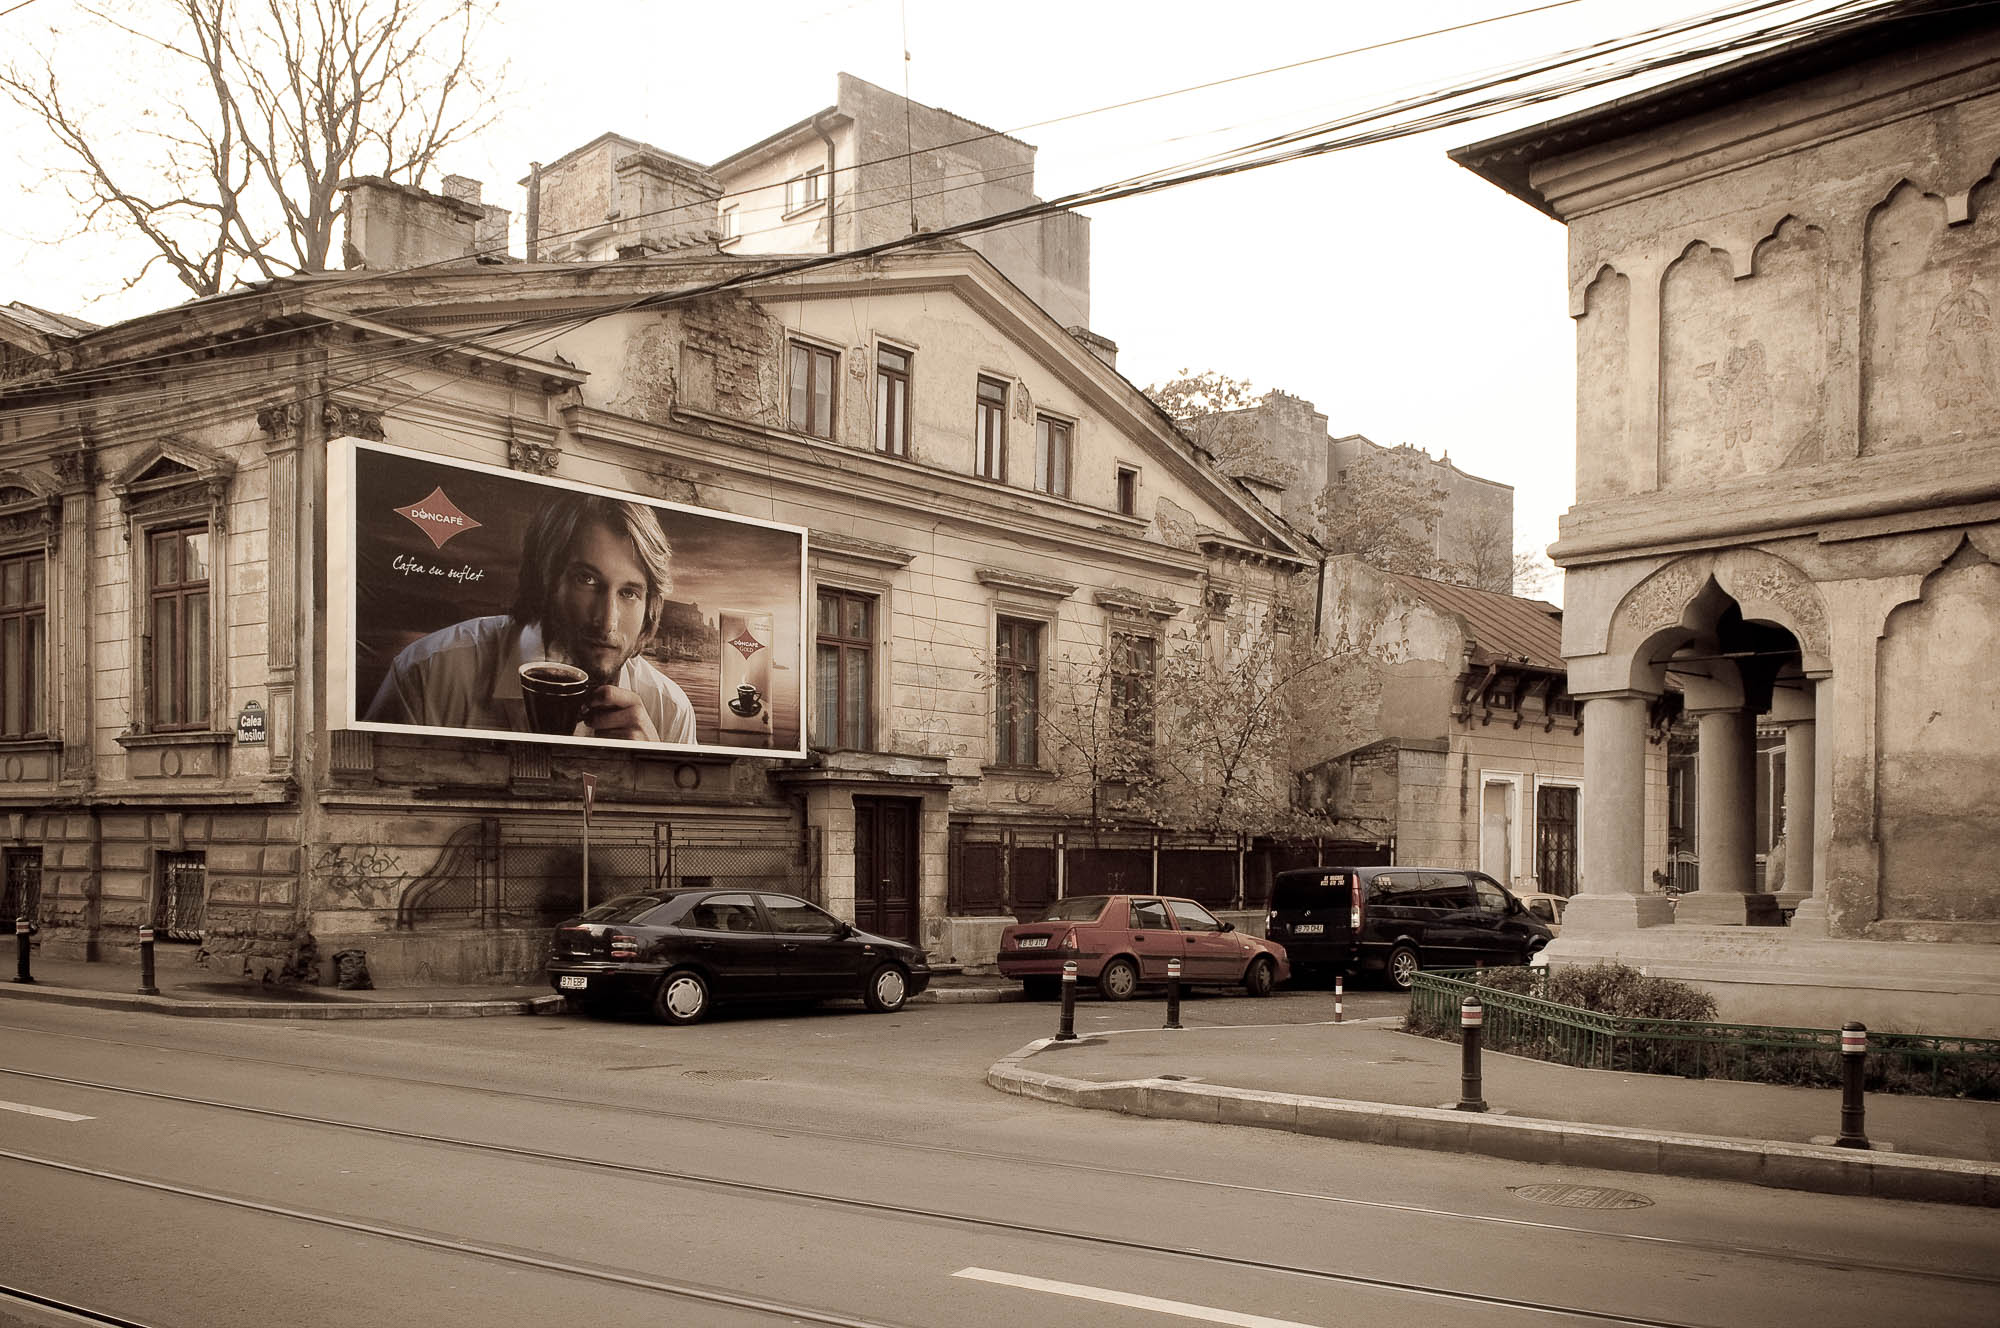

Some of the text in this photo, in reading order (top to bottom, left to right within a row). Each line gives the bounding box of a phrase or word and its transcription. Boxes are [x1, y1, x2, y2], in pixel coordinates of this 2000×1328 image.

[411, 508, 464, 526] DONCAFÉ
[392, 554, 426, 576] Cafea
[447, 565, 485, 583] suflet
[240, 714, 262, 727] Calea
